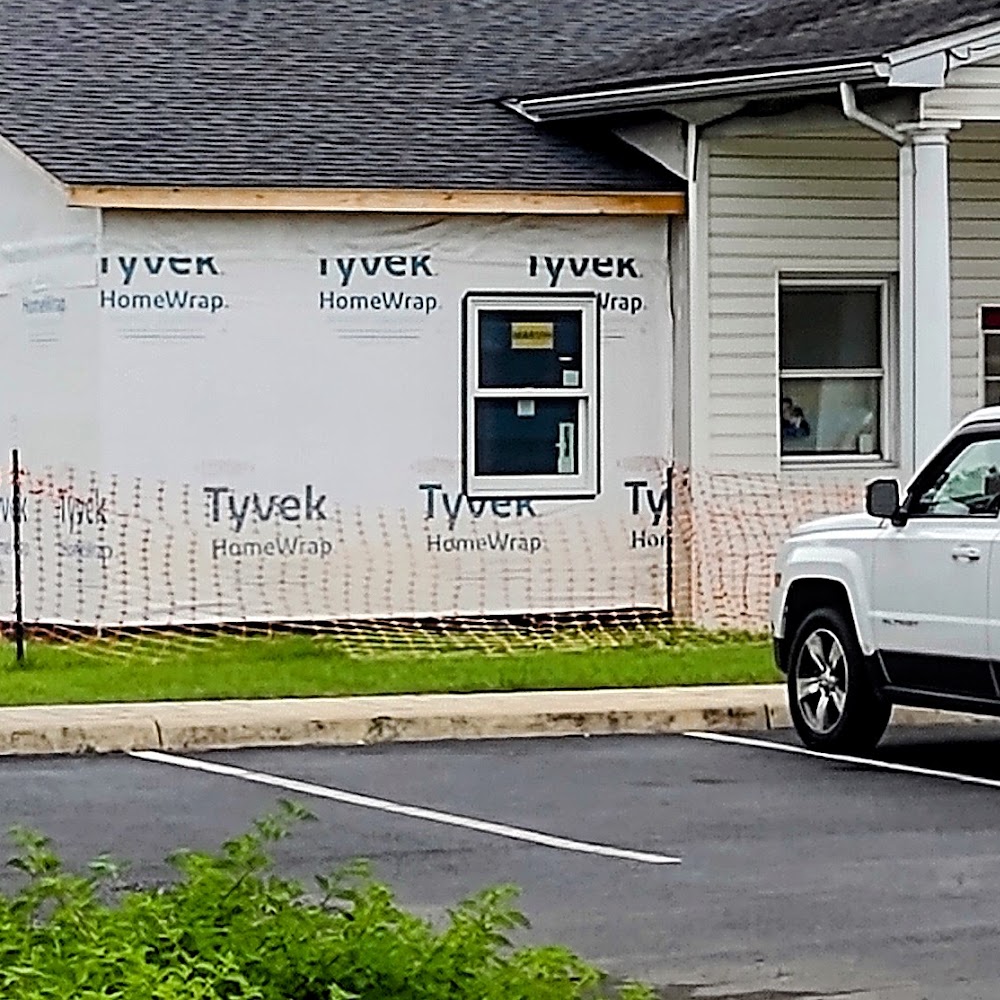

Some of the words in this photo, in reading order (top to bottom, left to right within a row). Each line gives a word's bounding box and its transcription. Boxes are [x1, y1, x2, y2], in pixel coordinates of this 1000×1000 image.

[101, 290, 225, 312] HomeWrap
[319, 291, 438, 313] HomeWrap
[203, 484, 327, 533] Tyvek
[211, 538, 332, 560] HomeWrap
[427, 534, 542, 553] HomeWrap
